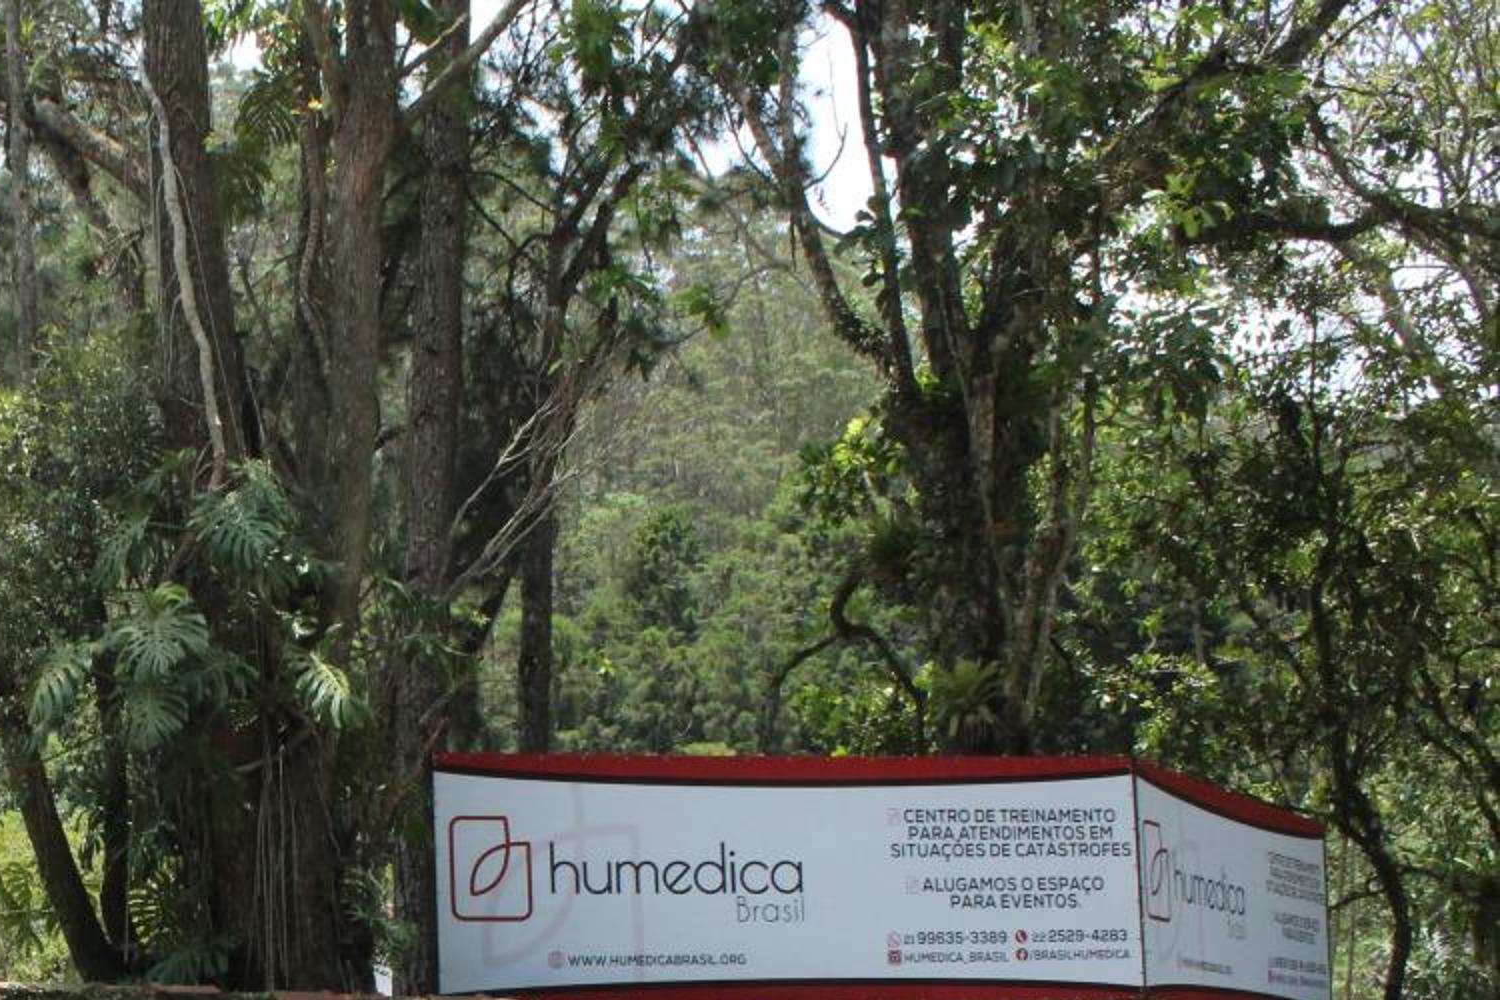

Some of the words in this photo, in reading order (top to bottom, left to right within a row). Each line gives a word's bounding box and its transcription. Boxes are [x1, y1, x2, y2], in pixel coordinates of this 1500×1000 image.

[903, 808, 971, 823] CENTRO
[974, 808, 996, 823] DE
[1001, 808, 1116, 823] TREINAMENTO
[908, 825, 954, 841] PARA
[958, 825, 1085, 841] ATENDIMENTOS
[1089, 826, 1113, 841] EM
[890, 838, 986, 861] SITUAÇÕES
[989, 843, 1011, 857] DE
[549, 841, 804, 895] humedica
[923, 877, 1017, 892] ALUGAMOS
[1021, 877, 1033, 892] O
[1037, 876, 1105, 895] ESPAÇO
[736, 896, 806, 924] Brasil
[950, 895, 996, 909] PARA
[567, 953, 748, 967] WWW.HUMEDICABRASIL.ORG
